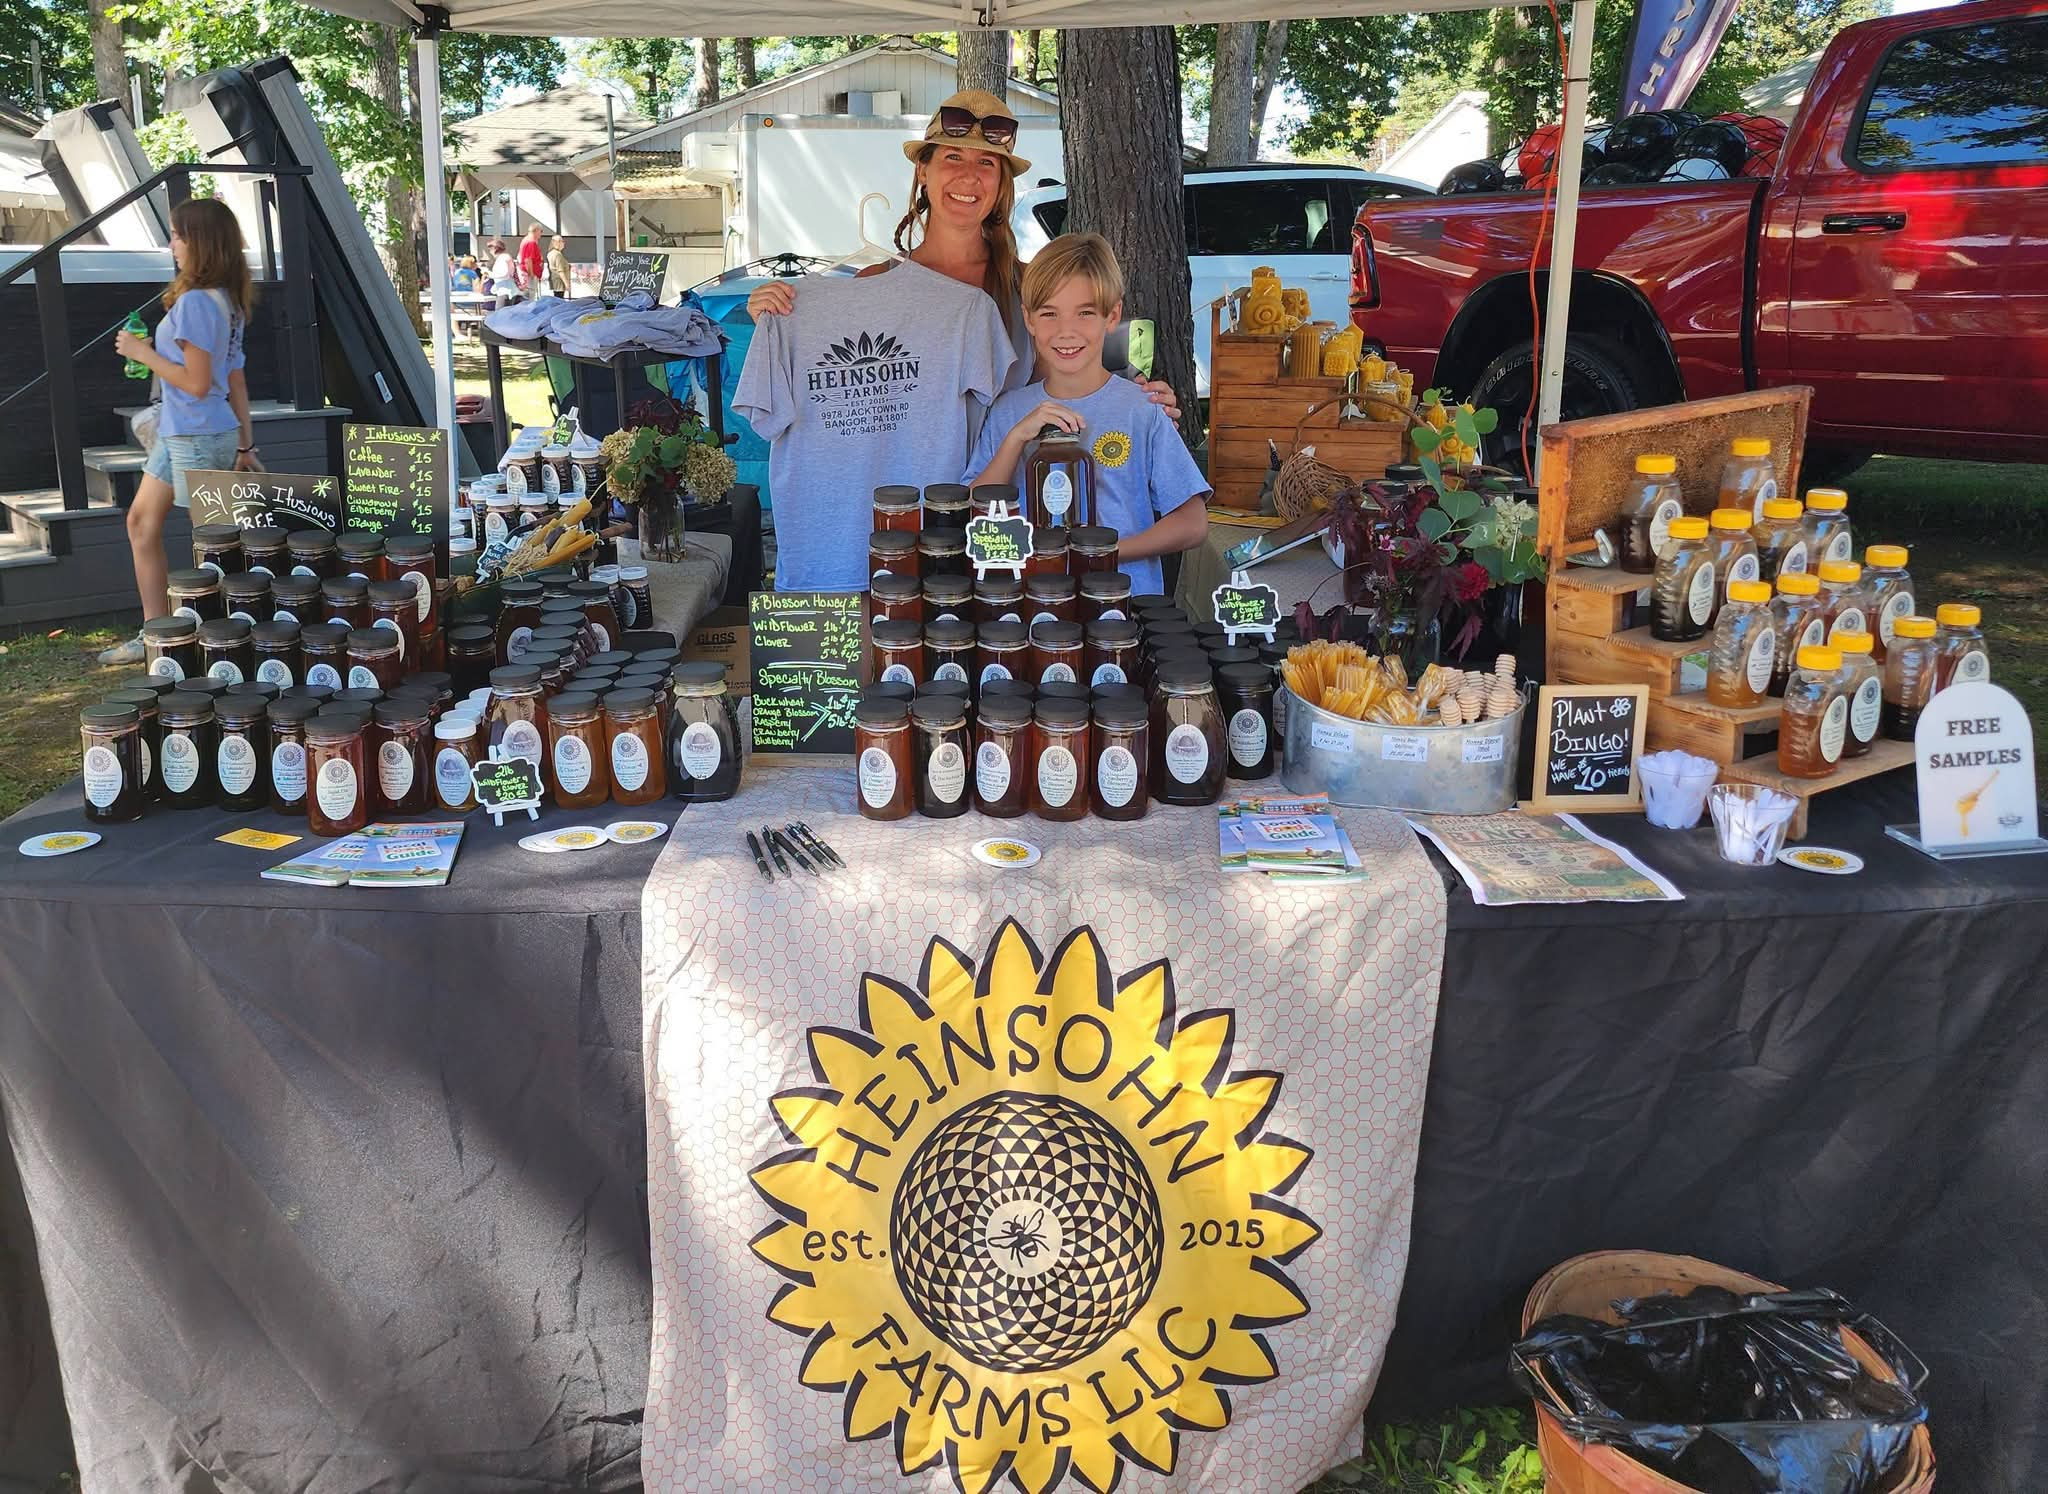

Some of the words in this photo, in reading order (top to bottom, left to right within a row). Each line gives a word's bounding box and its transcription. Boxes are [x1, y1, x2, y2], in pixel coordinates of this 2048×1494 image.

[807, 361, 920, 391] HEINSOHN
[844, 384, 889, 400] FARMS
[821, 410, 842, 420] 9978
[846, 404, 897, 418] JACKTOWN
[900, 402, 909, 411] RD
[873, 414, 883, 424] PA
[840, 422, 897, 437] 407-949-1383
[349, 446, 383, 464] Coffee
[191, 484, 228, 516] TRY
[231, 483, 266, 501] OUR
[232, 505, 278, 530] FREE
[760, 594, 810, 611] Blossom
[813, 594, 847, 616] Honey
[754, 635, 793, 648] Clover
[758, 667, 813, 692] Specialty
[812, 669, 861, 689] Blossom
[1947, 717, 2001, 736] FREE
[1550, 728, 1628, 753] BINGO!
[1550, 759, 1567, 772] WE
[1930, 748, 2021, 769] SAMPLES
[1551, 768, 1577, 784] HAVE
[1269, 830, 1318, 840] Guide
[386, 849, 437, 860] Guide
[826, 1004, 1226, 1193] HEINSOHN
[803, 1229, 888, 1262] est.
[1179, 1219, 1266, 1251] 2015
[852, 1312, 1072, 1446] FARMS
[1086, 1306, 1217, 1425] LLC
